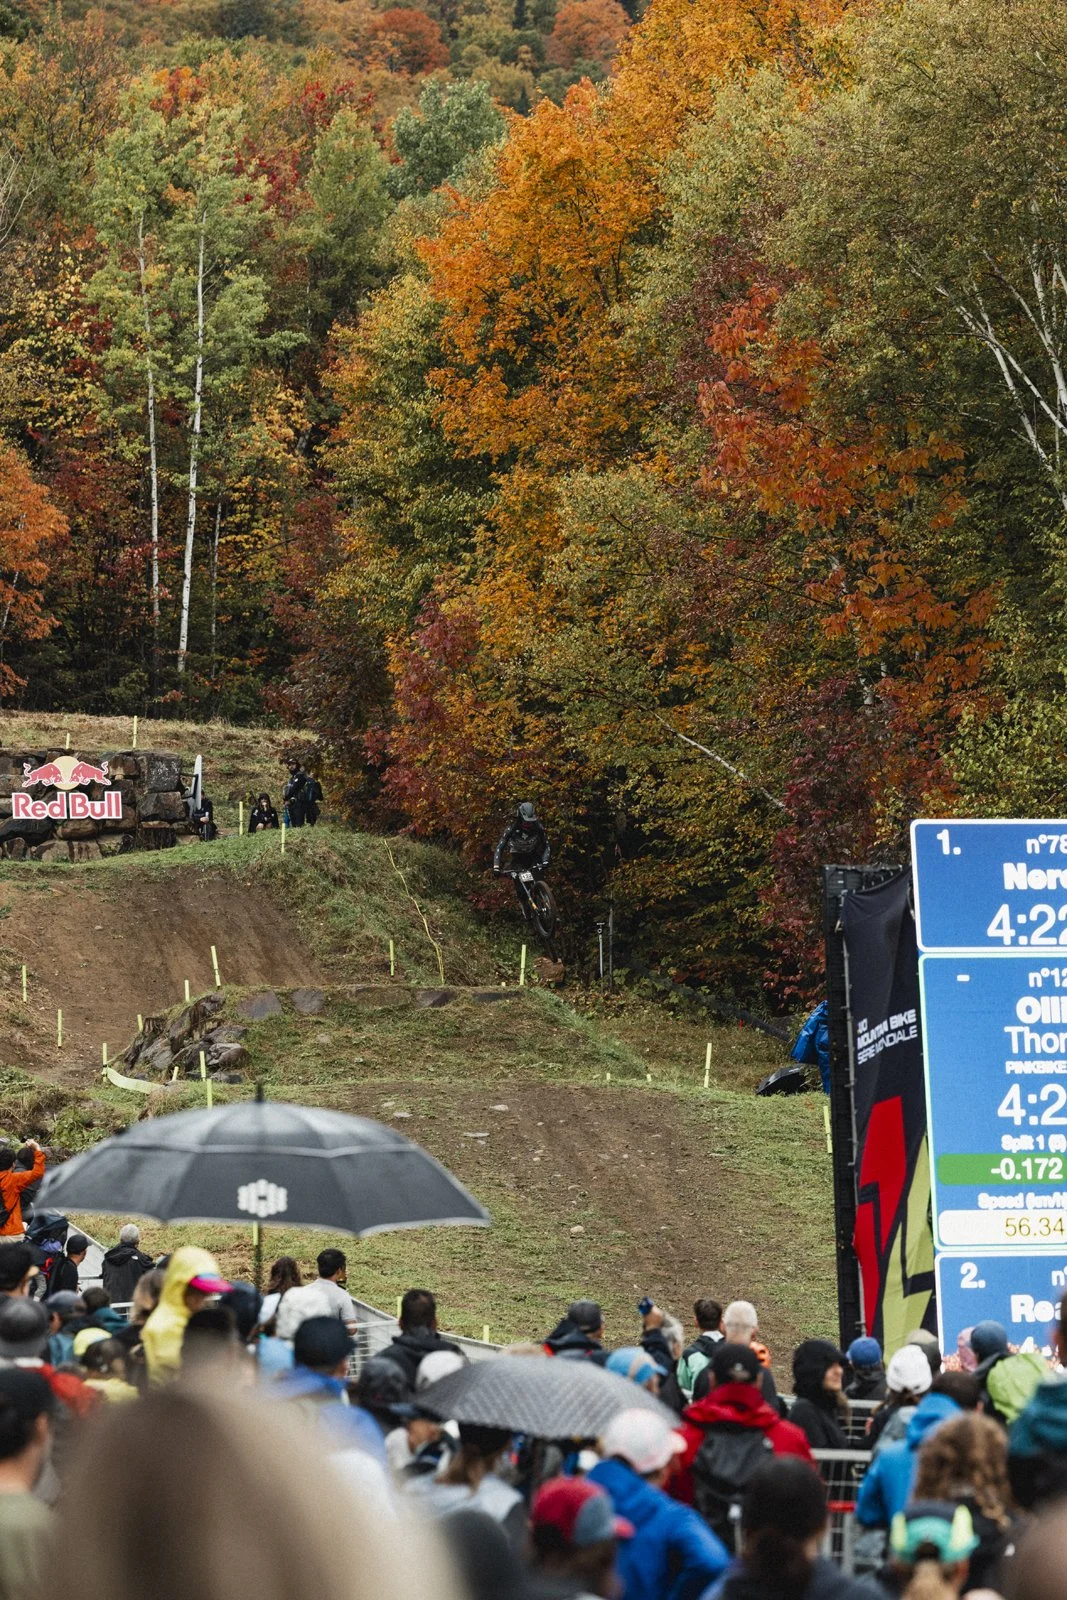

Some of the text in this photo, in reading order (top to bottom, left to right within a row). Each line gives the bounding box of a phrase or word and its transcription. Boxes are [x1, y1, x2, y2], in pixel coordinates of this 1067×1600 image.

[12, 791, 122, 819] Red Bull
[936, 829, 961, 855] 1.
[889, 1009, 917, 1030] BIKE
[1036, 1134, 1045, 1150] 1
[990, 1157, 1063, 1180] -0.172
[1005, 1217, 1064, 1236] 56.34
[960, 1262, 986, 1288] 2.
